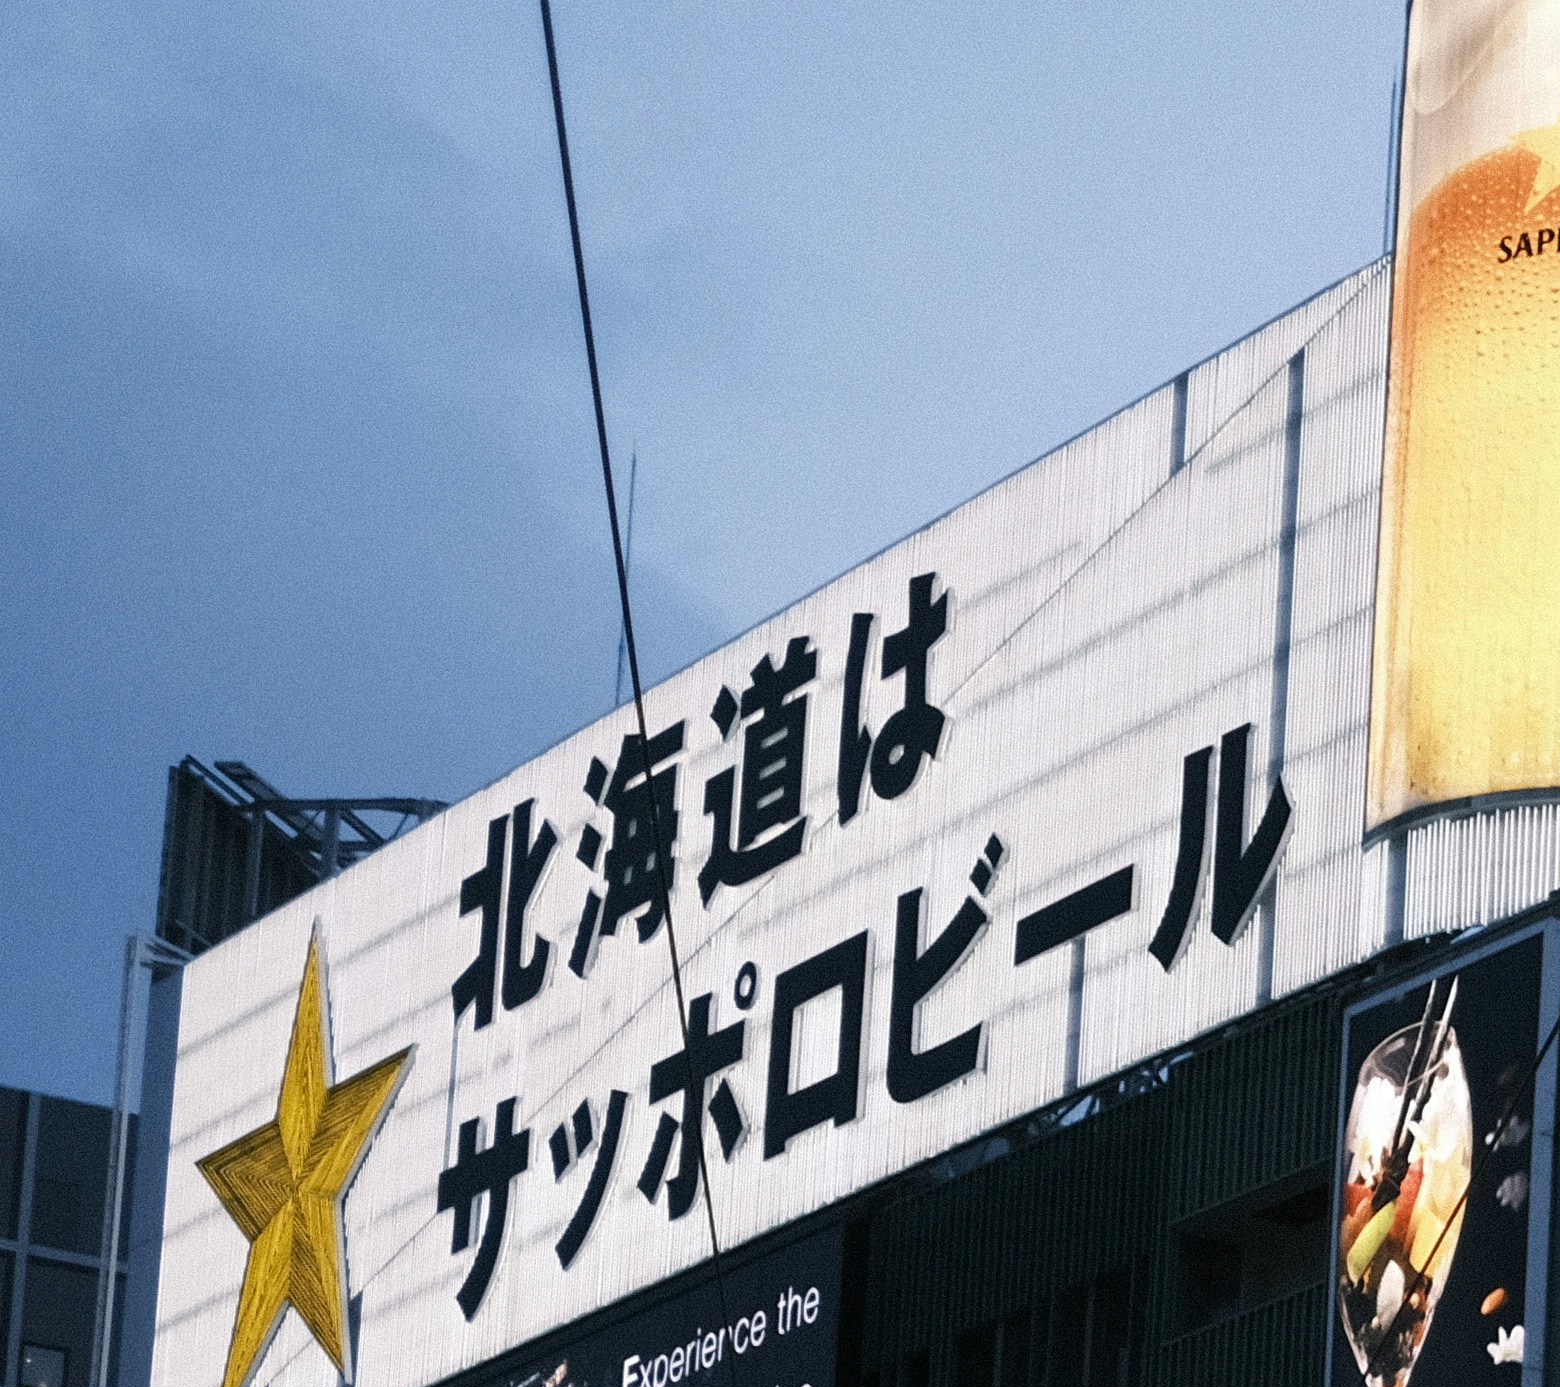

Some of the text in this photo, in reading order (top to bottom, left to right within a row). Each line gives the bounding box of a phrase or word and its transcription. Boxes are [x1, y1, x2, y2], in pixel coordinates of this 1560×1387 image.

[436, 722, 1295, 1322] サッポロビール
[452, 570, 952, 1032] 北海道は
[777, 1286, 819, 1347] the
